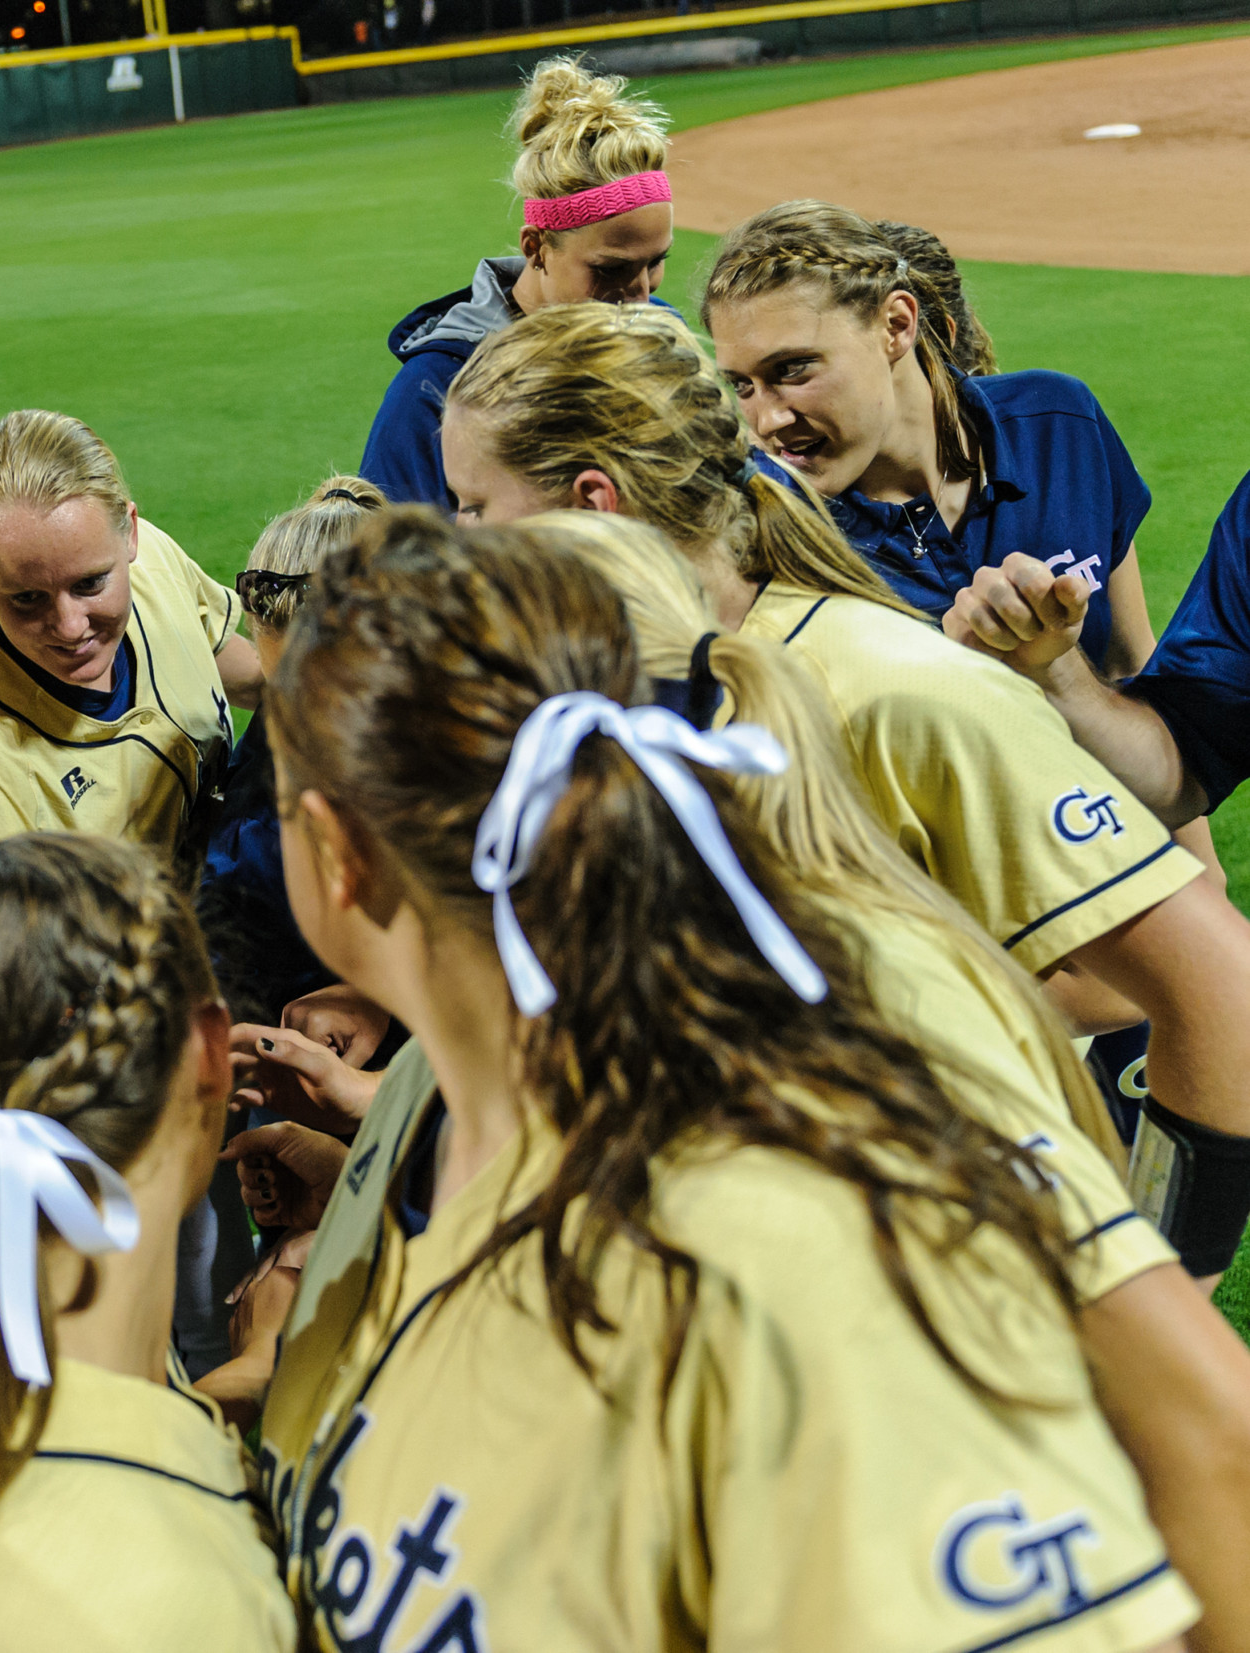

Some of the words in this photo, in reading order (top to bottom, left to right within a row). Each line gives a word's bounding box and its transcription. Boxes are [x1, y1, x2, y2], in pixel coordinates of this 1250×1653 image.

[70, 778, 97, 810] RUSSELL
[1051, 785, 1124, 844] GT
[937, 1492, 1097, 1615] GT
